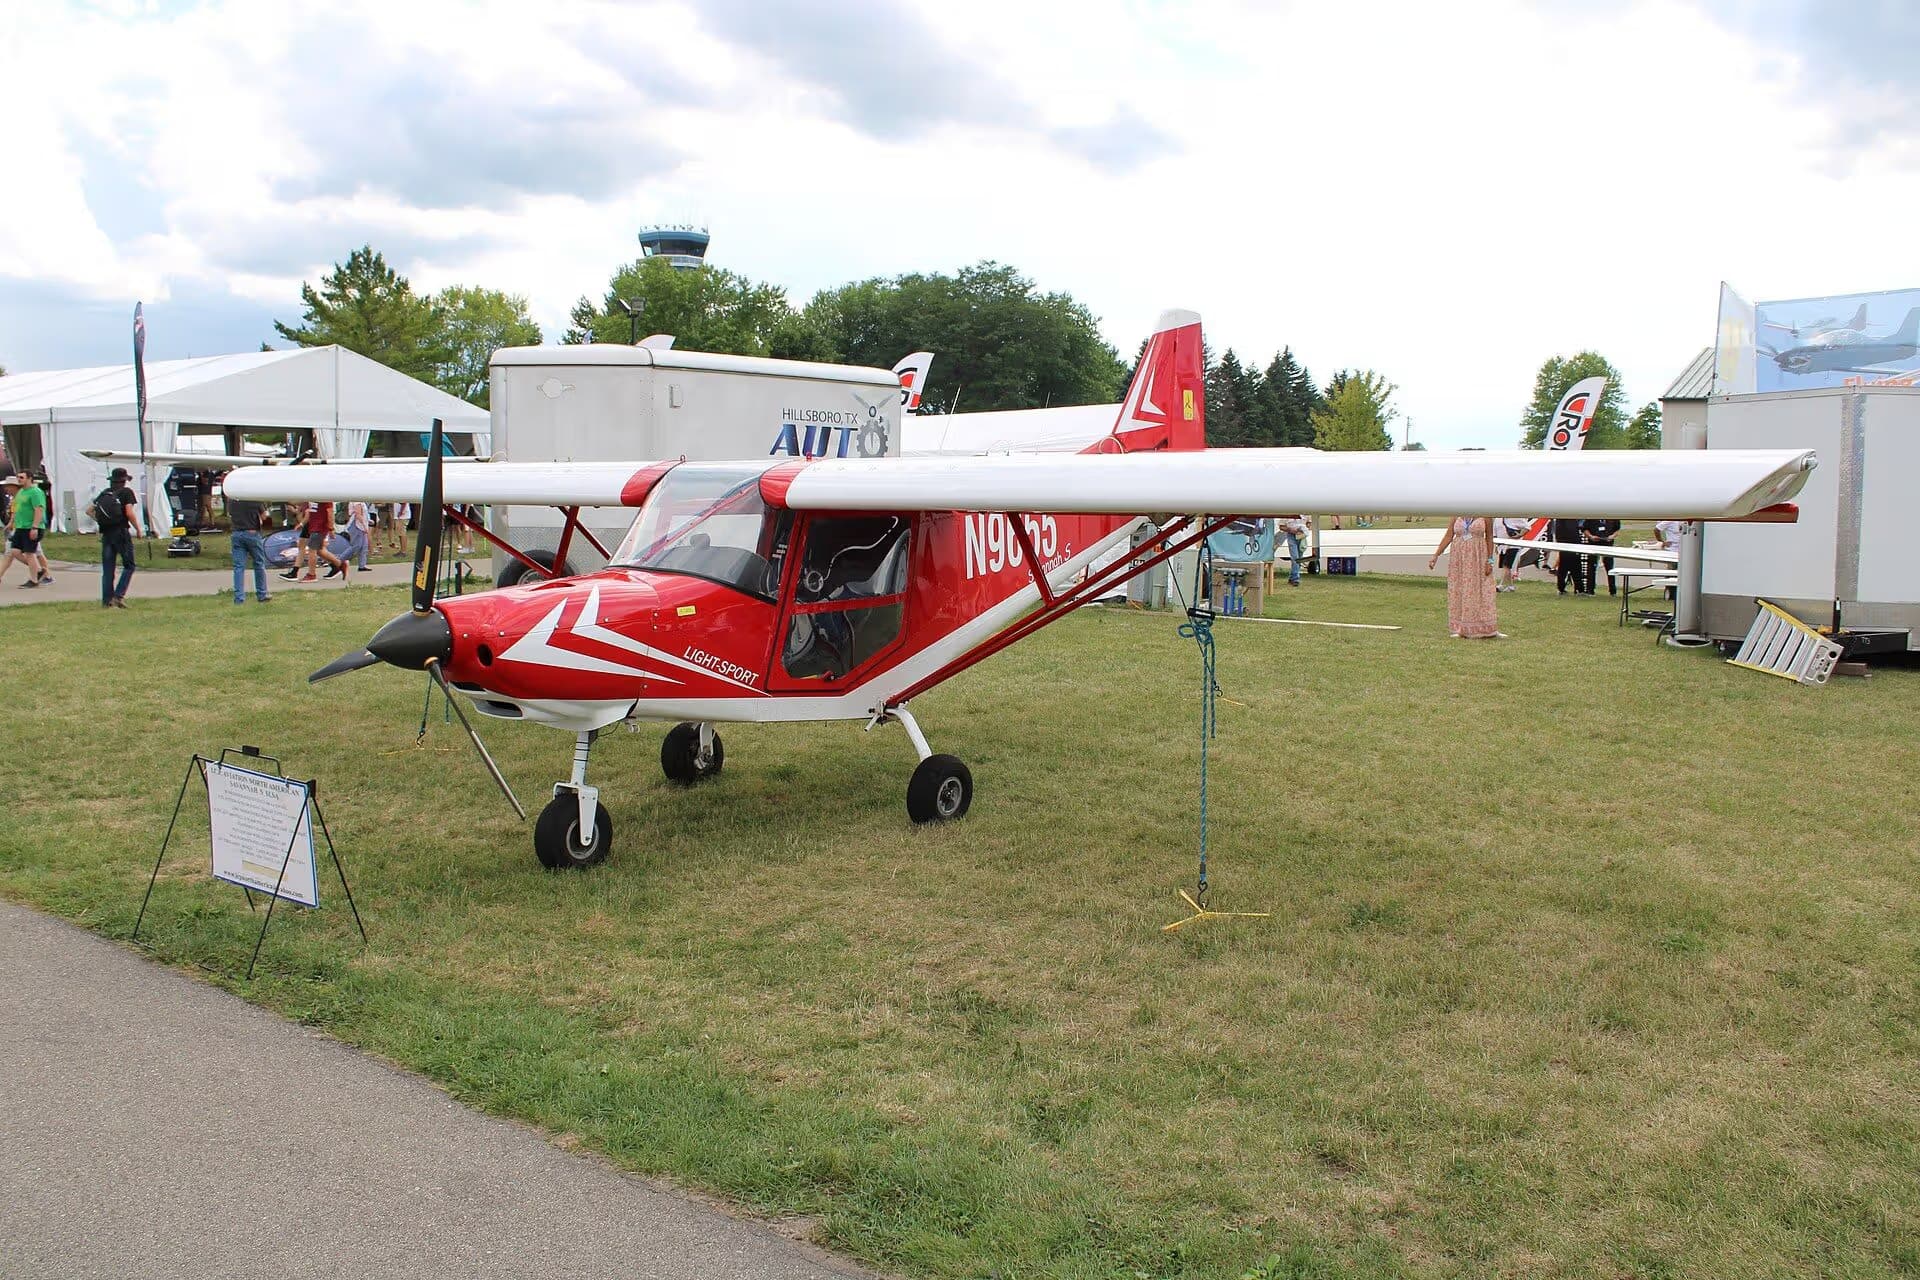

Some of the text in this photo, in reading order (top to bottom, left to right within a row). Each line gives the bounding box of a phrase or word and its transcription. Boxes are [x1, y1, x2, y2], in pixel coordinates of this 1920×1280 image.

[782, 408, 858, 425] HILLSBORO, TX
[683, 645, 759, 686] LIGHT-SPORT
